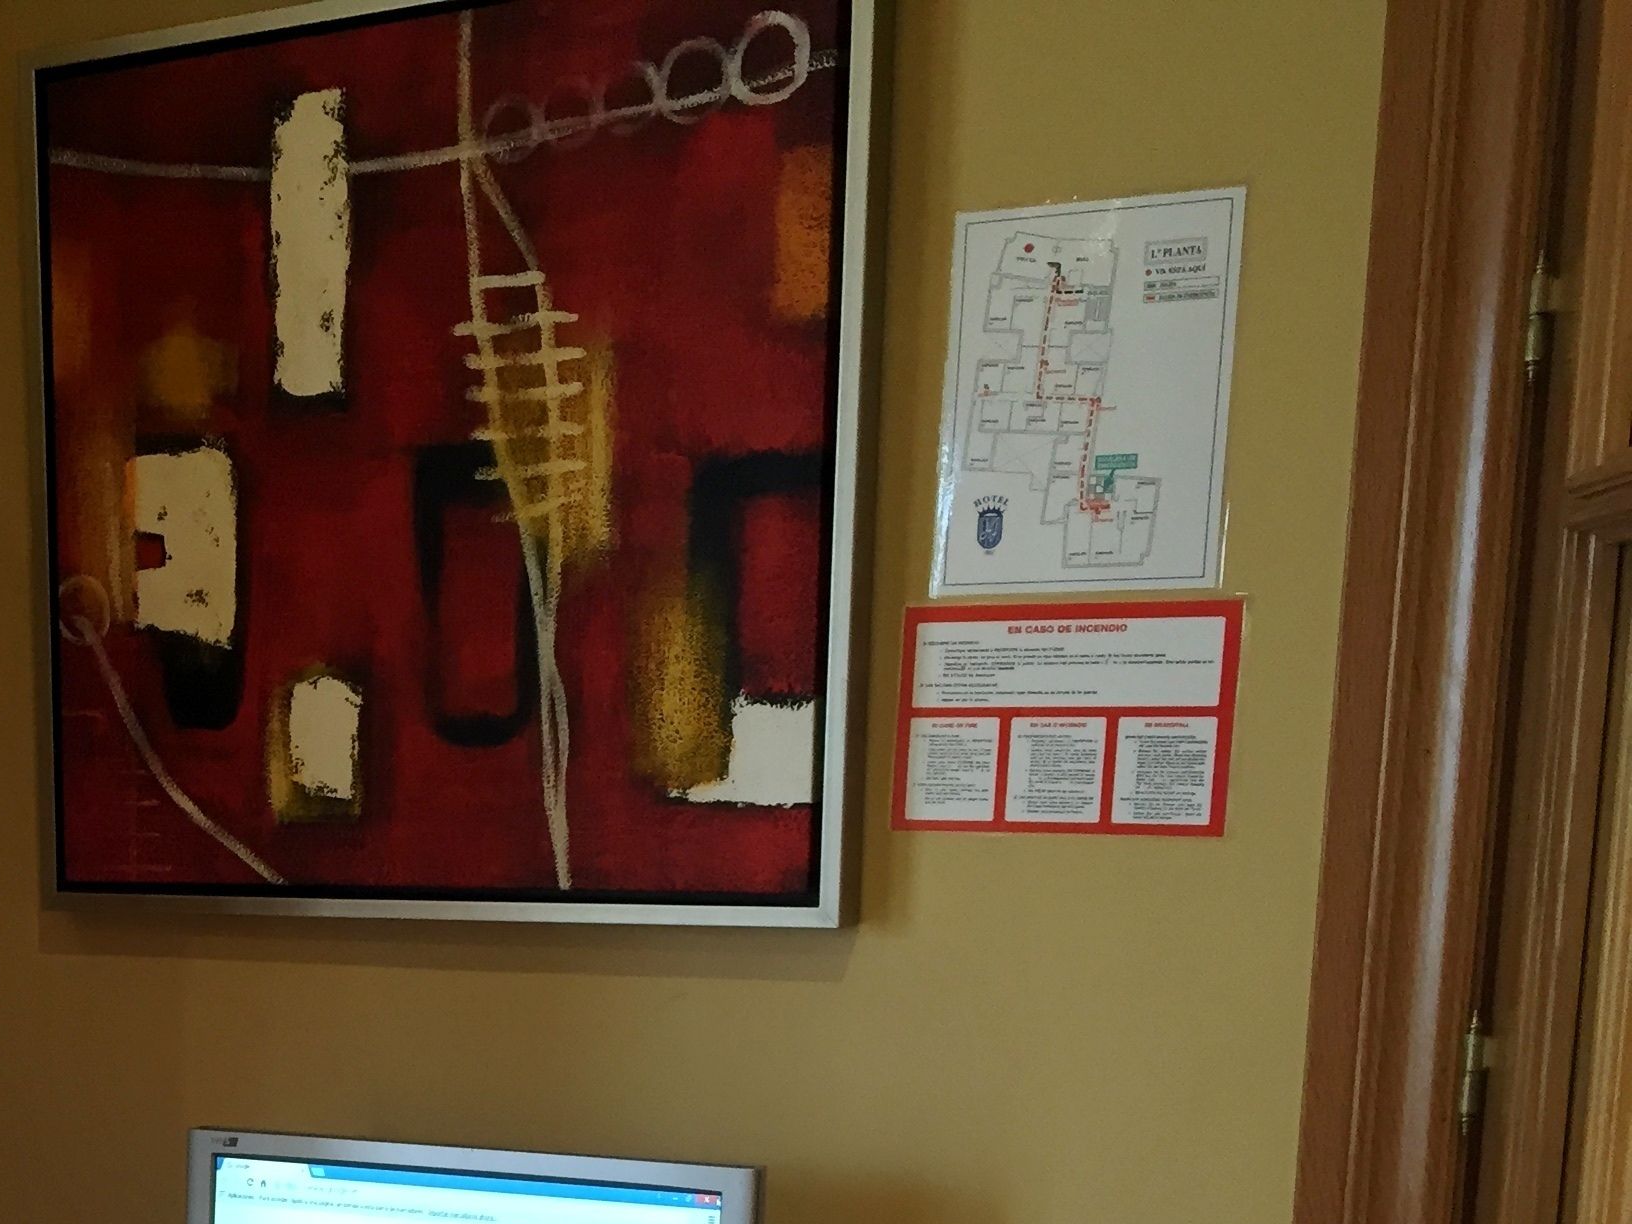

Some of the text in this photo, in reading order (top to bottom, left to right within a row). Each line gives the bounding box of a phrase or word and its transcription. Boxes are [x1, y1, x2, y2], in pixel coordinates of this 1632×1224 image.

[1163, 245, 1202, 258] PLANTA
[973, 495, 1009, 507] HOTEL
[1007, 623, 1128, 635] EN CASO DE INCENDIO
